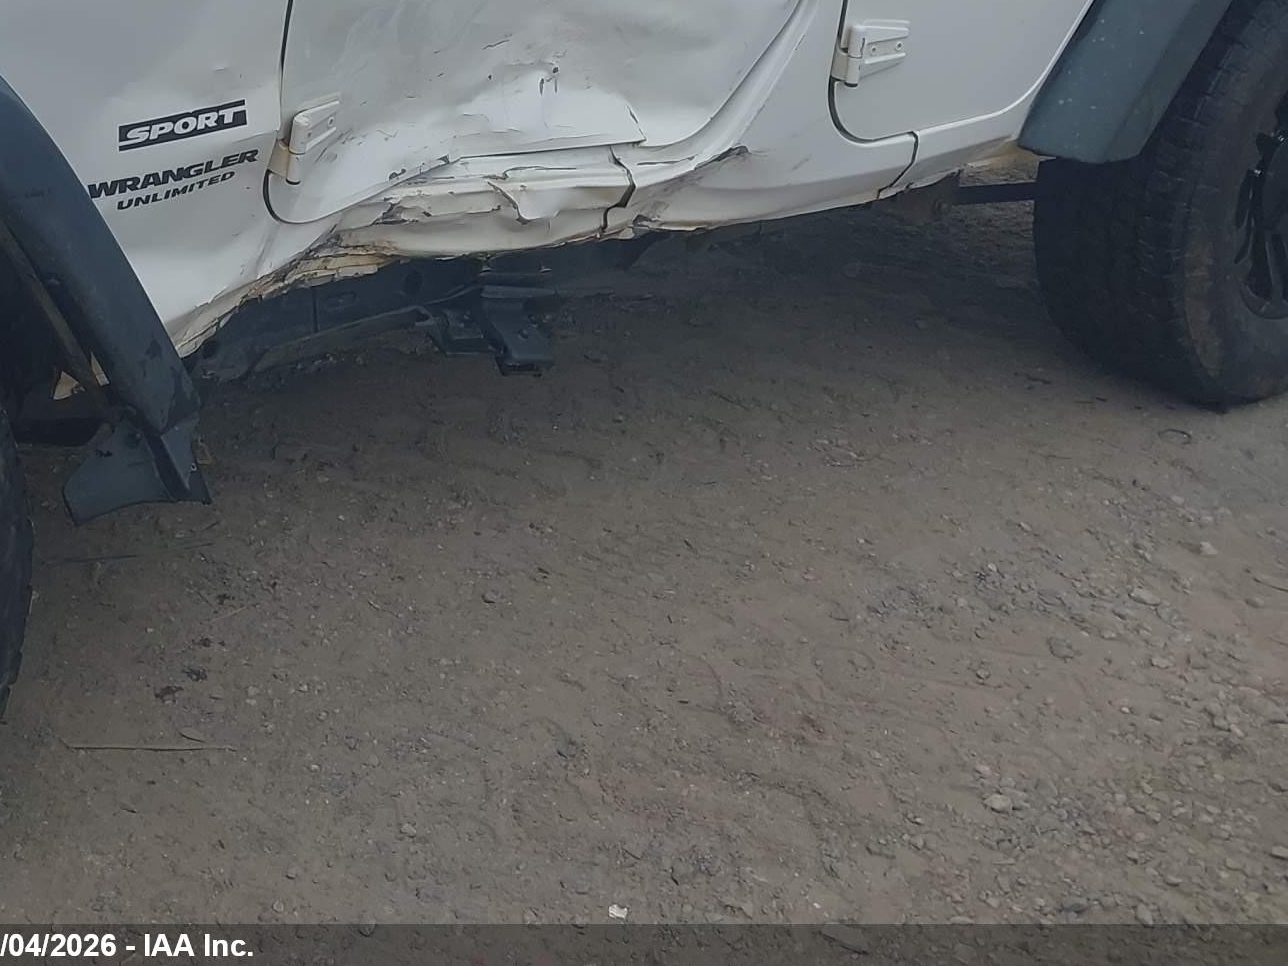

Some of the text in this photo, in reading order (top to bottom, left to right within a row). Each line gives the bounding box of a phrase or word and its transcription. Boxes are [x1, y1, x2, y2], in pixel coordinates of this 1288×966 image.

[119, 105, 246, 147] SPORT
[87, 149, 259, 200] WRANGLER
[116, 170, 236, 211] UNLIMITED
